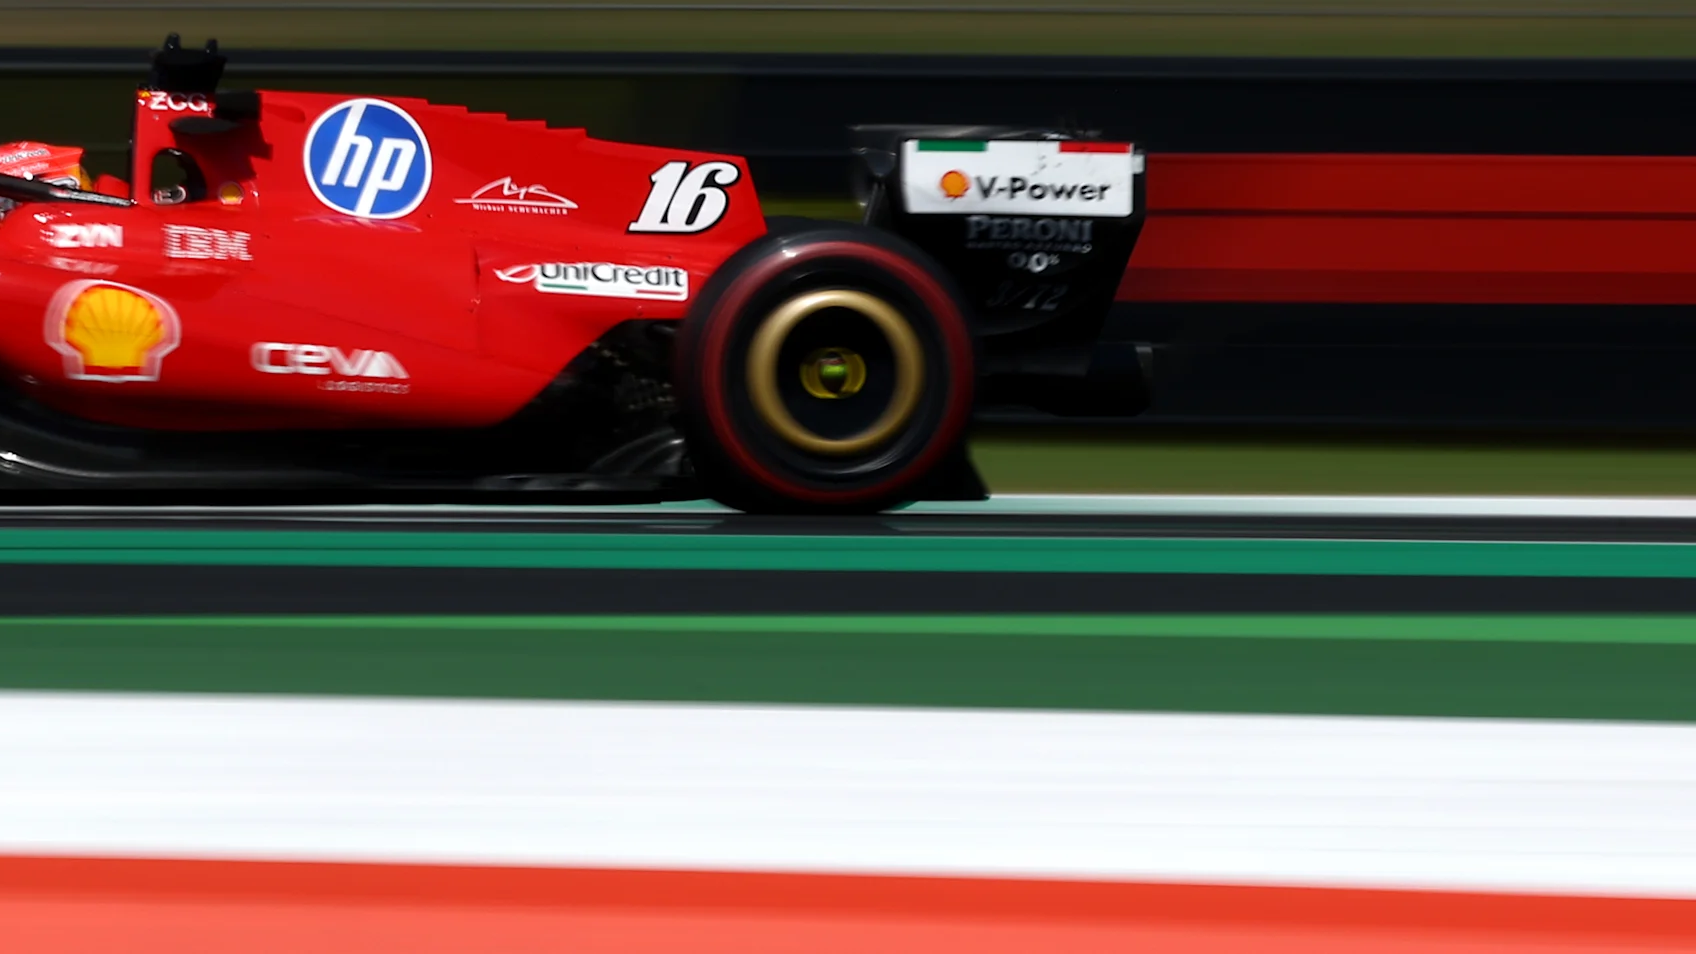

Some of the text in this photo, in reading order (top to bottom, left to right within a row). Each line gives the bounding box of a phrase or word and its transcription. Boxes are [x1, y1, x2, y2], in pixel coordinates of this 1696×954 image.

[320, 100, 417, 218] hp
[626, 160, 741, 234] 16
[975, 175, 1112, 201] V-Power
[507, 205, 568, 215] SCHUMACHER
[162, 223, 254, 261] IBM
[965, 214, 1094, 242] PERONI
[540, 262, 684, 287] UniCredit
